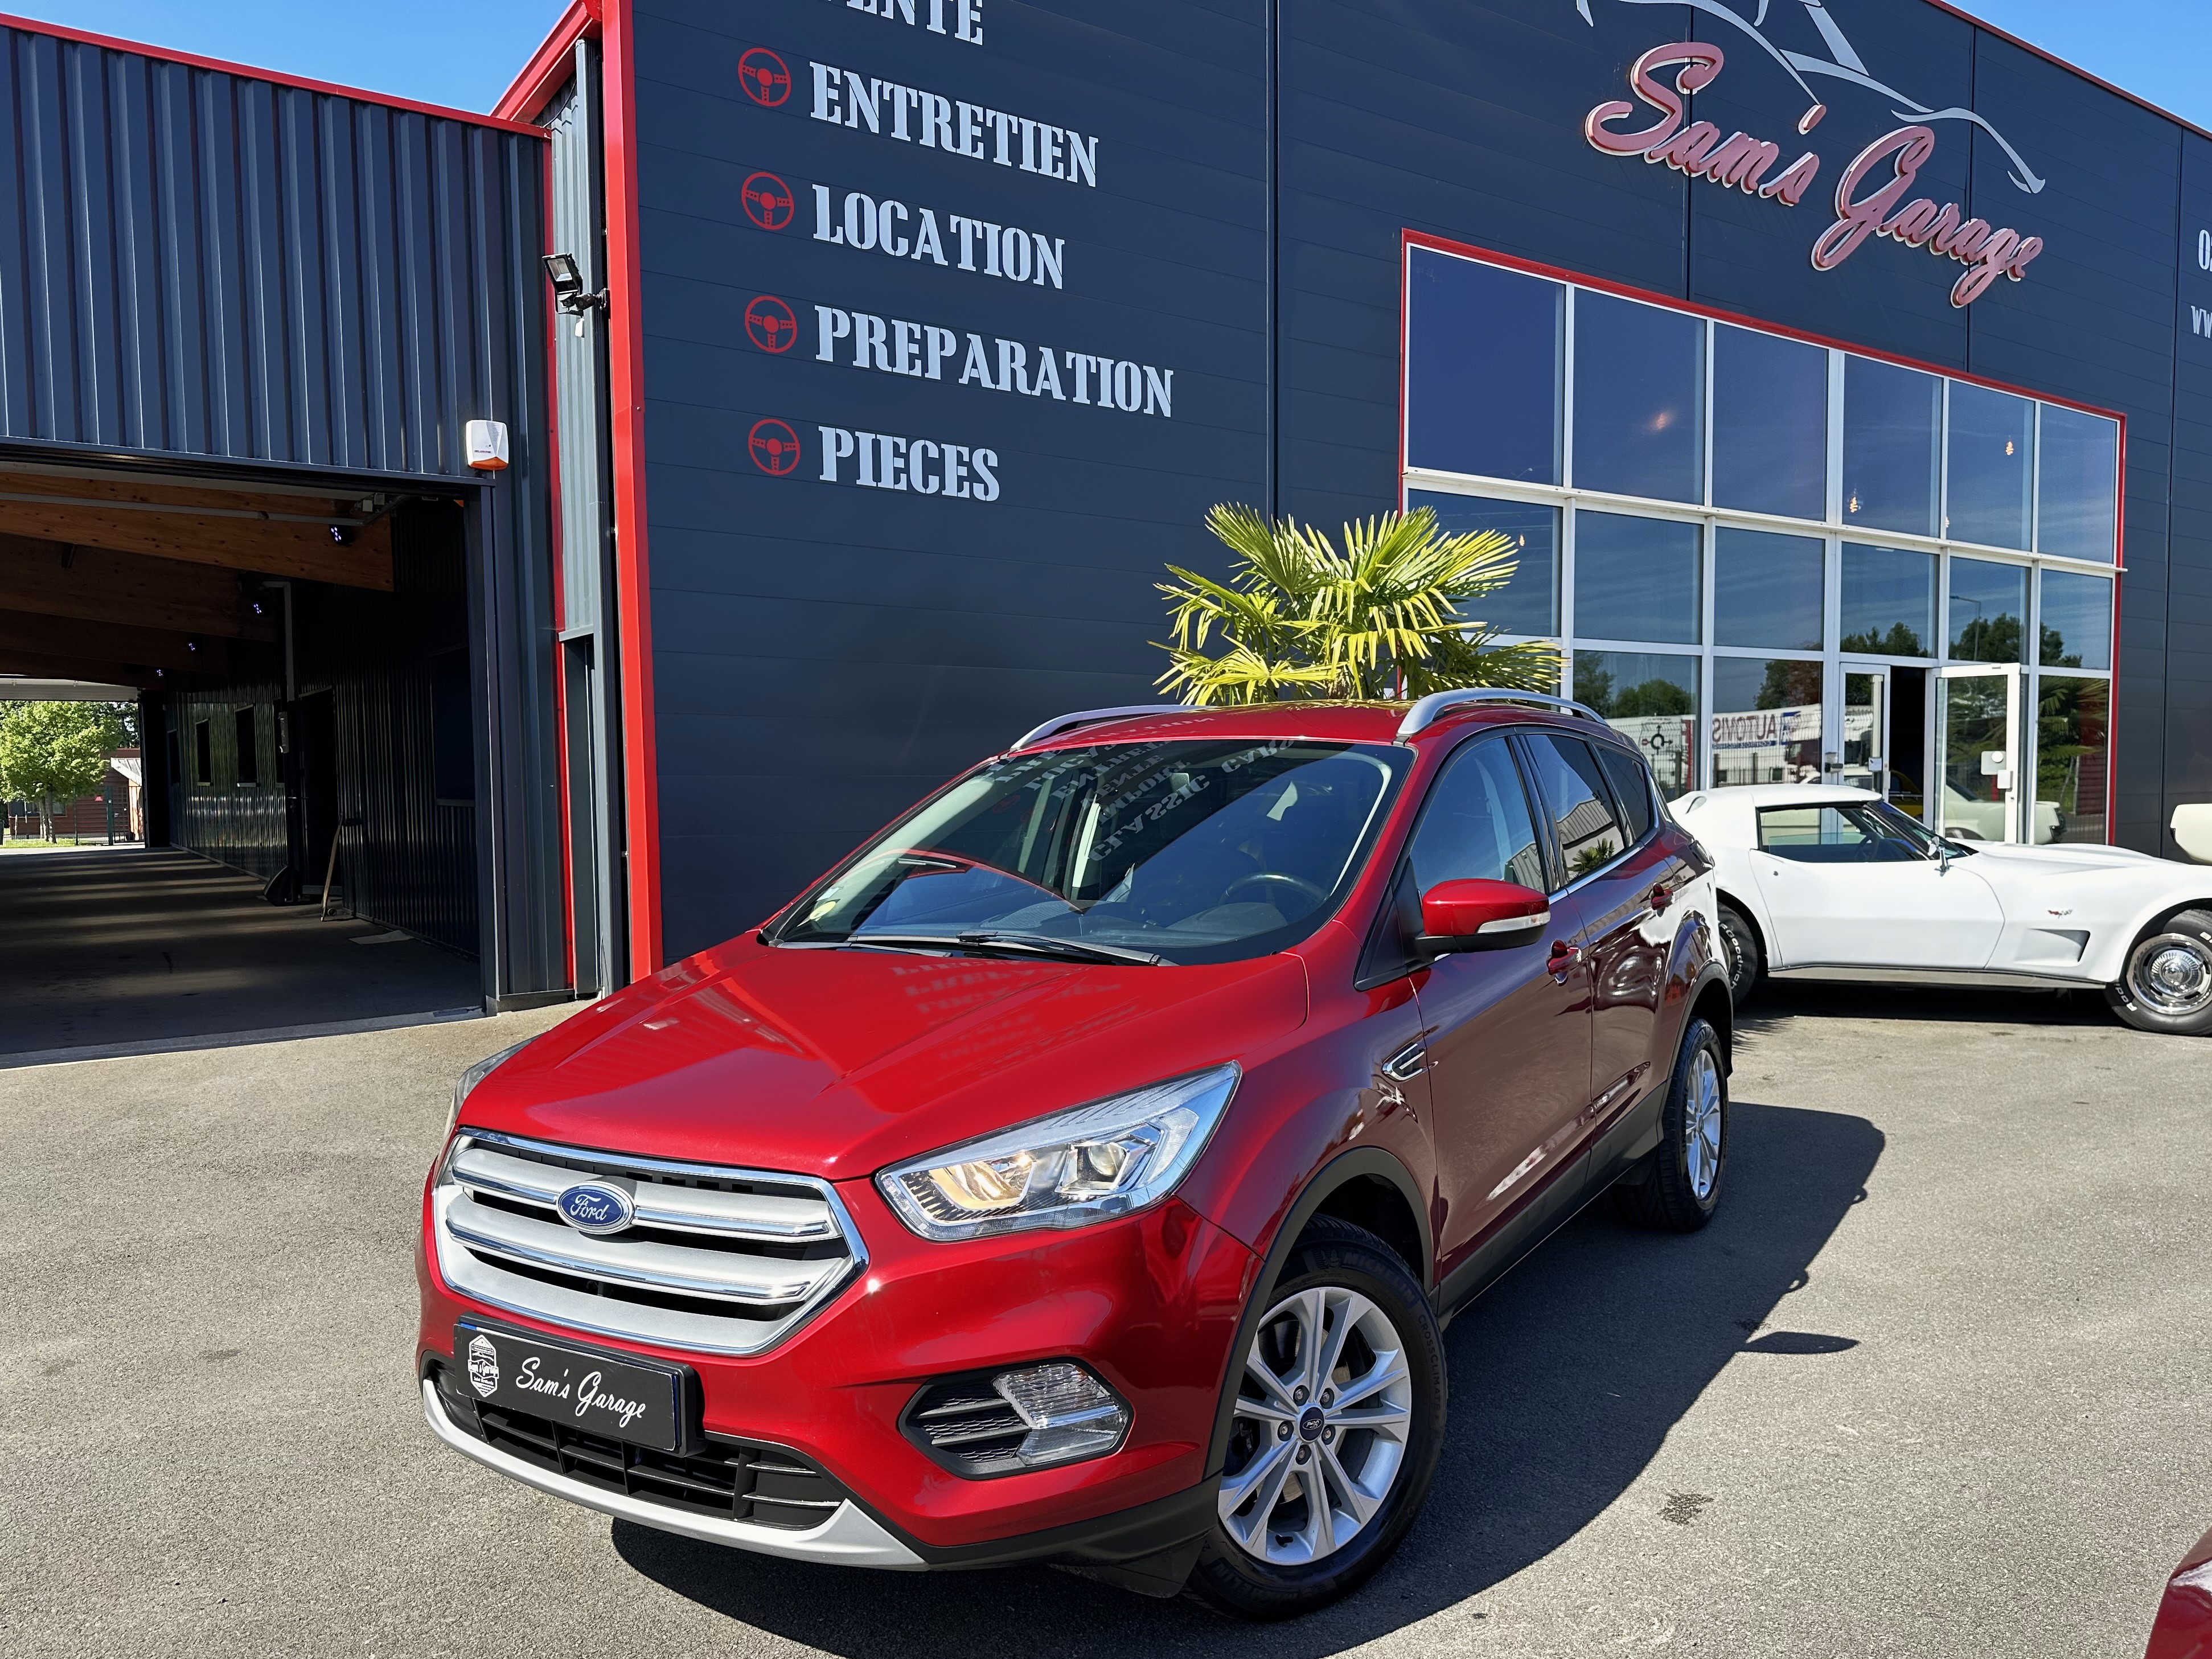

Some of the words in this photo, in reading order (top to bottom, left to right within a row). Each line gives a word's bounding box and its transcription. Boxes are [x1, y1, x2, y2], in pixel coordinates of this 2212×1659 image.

[809, 61, 1099, 188] ENTRETIEN
[1585, 42, 1827, 207] Sam's
[1811, 125, 2043, 309] Garage
[812, 184, 1065, 289] LOCATION
[2198, 229, 2212, 273] 0
[814, 305, 1174, 418] PREPARATION
[818, 425, 1000, 502] PIECES
[1717, 919, 1744, 990] FGoodrich
[570, 1194, 610, 1221] Ford
[1342, 1251, 1419, 1307] MICHELIN
[515, 1356, 571, 1399] Sam's
[575, 1371, 647, 1428] Garage
